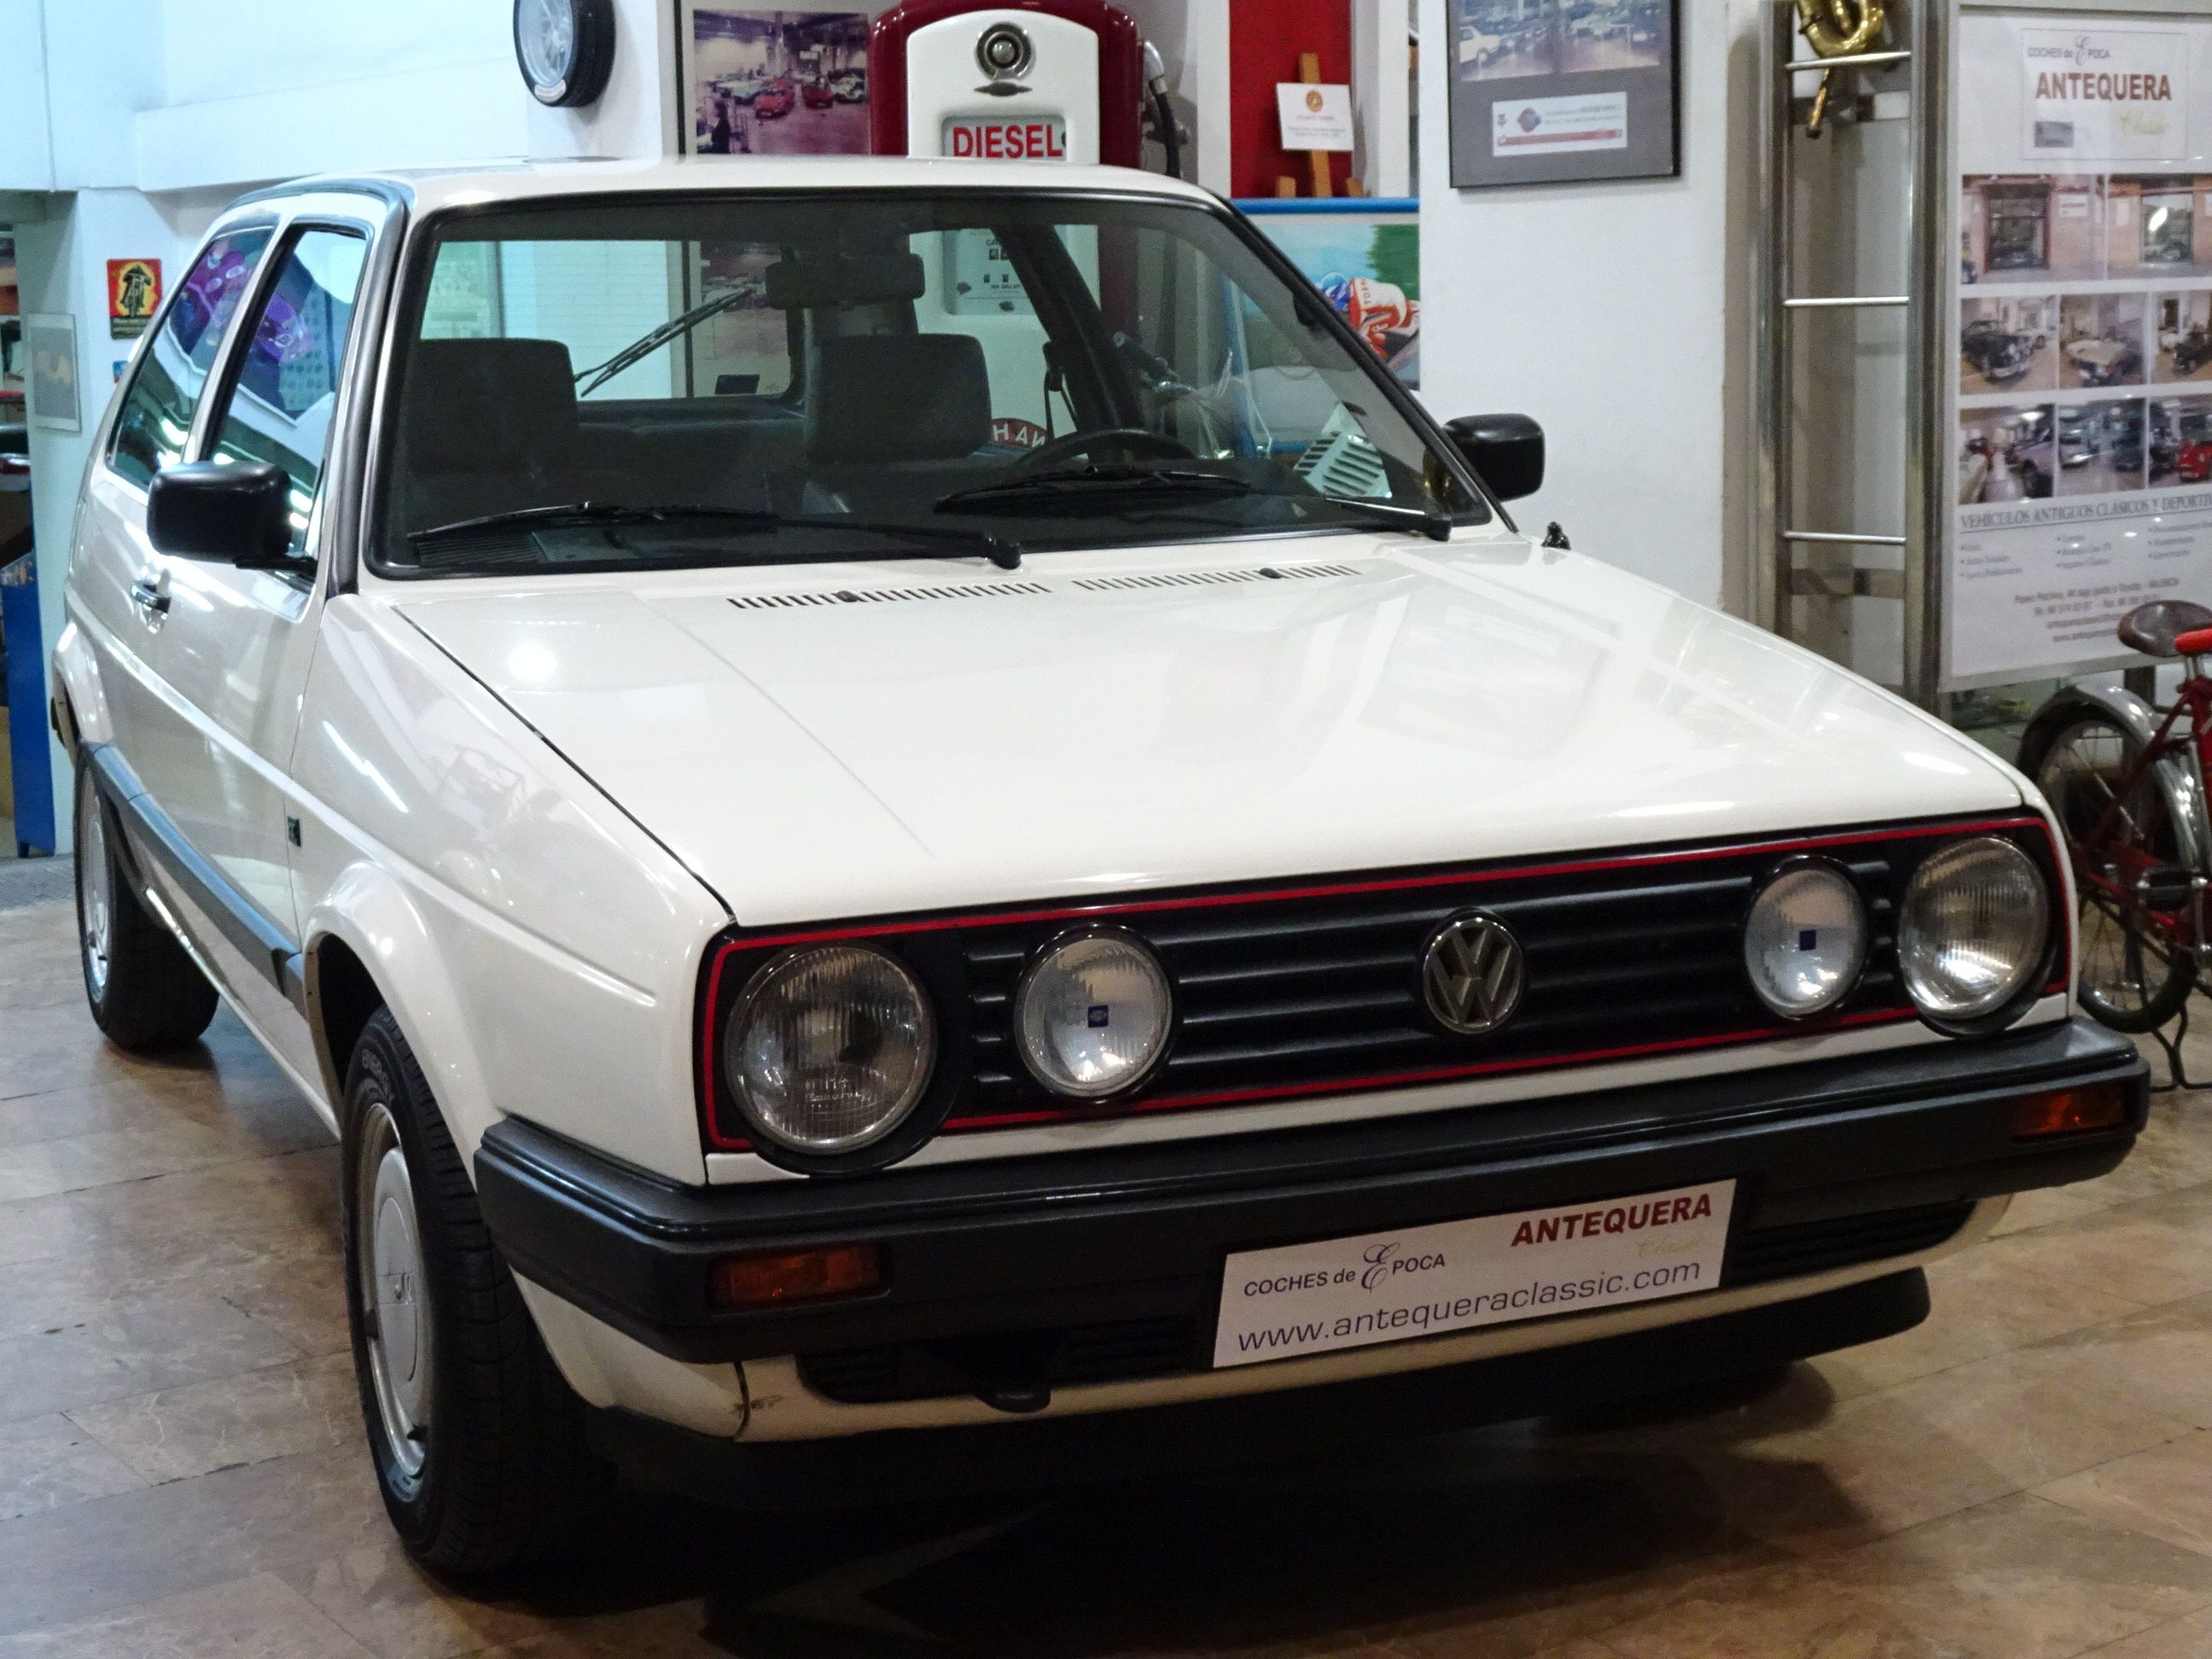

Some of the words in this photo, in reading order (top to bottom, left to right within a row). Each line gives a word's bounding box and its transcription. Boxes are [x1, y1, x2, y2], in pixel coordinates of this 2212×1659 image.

[2035, 72, 2172, 101] ANTEQUERA
[952, 124, 1062, 159] DIESEL
[1510, 1193, 1712, 1248] ANTEQUERA
[1243, 1272, 1329, 1296] COCHES
[1333, 1268, 1356, 1284] de
[1238, 1261, 1701, 1352] www.antequeraclassic.com
